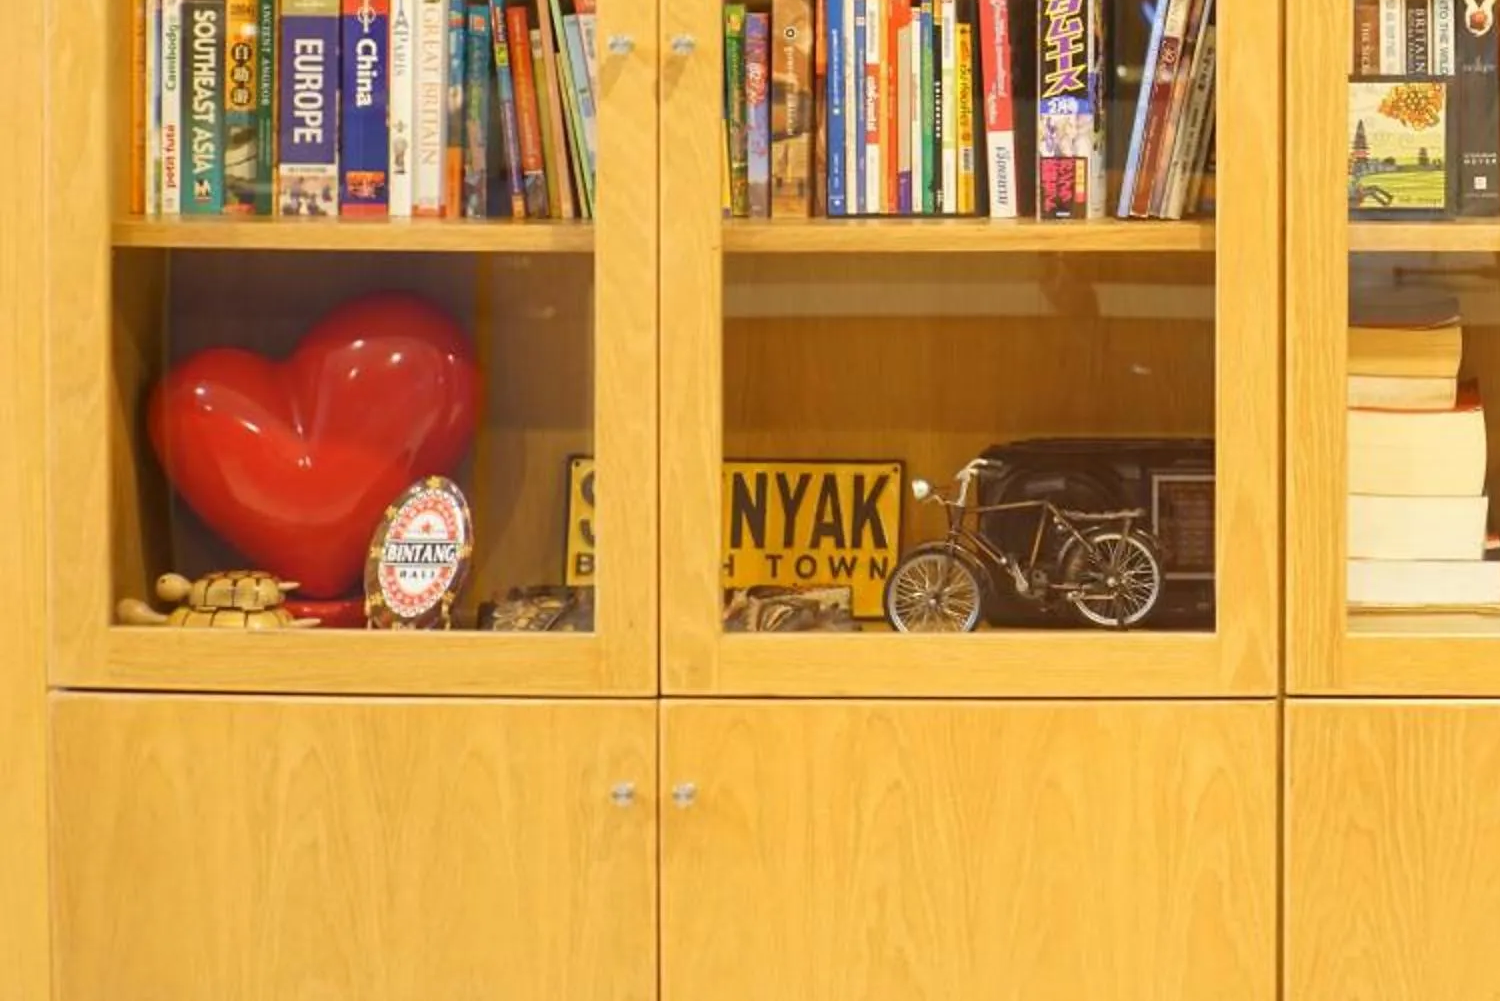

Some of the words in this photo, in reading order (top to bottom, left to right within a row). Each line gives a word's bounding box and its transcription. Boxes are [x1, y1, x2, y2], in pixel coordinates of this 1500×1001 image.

[261, 3, 271, 52] ANCIENT
[422, 8, 441, 75] GREAT
[1415, 8, 1426, 72] BRITAIN
[1439, 22, 1449, 44] THE
[192, 9, 217, 124] SOUTHEAST
[293, 38, 324, 144] EUROPE
[356, 38, 379, 108] China
[192, 127, 216, 174] ASIA
[422, 82, 441, 166] BRITAIN
[386, 544, 457, 563] BINTANG
[765, 554, 889, 580] TOWN
